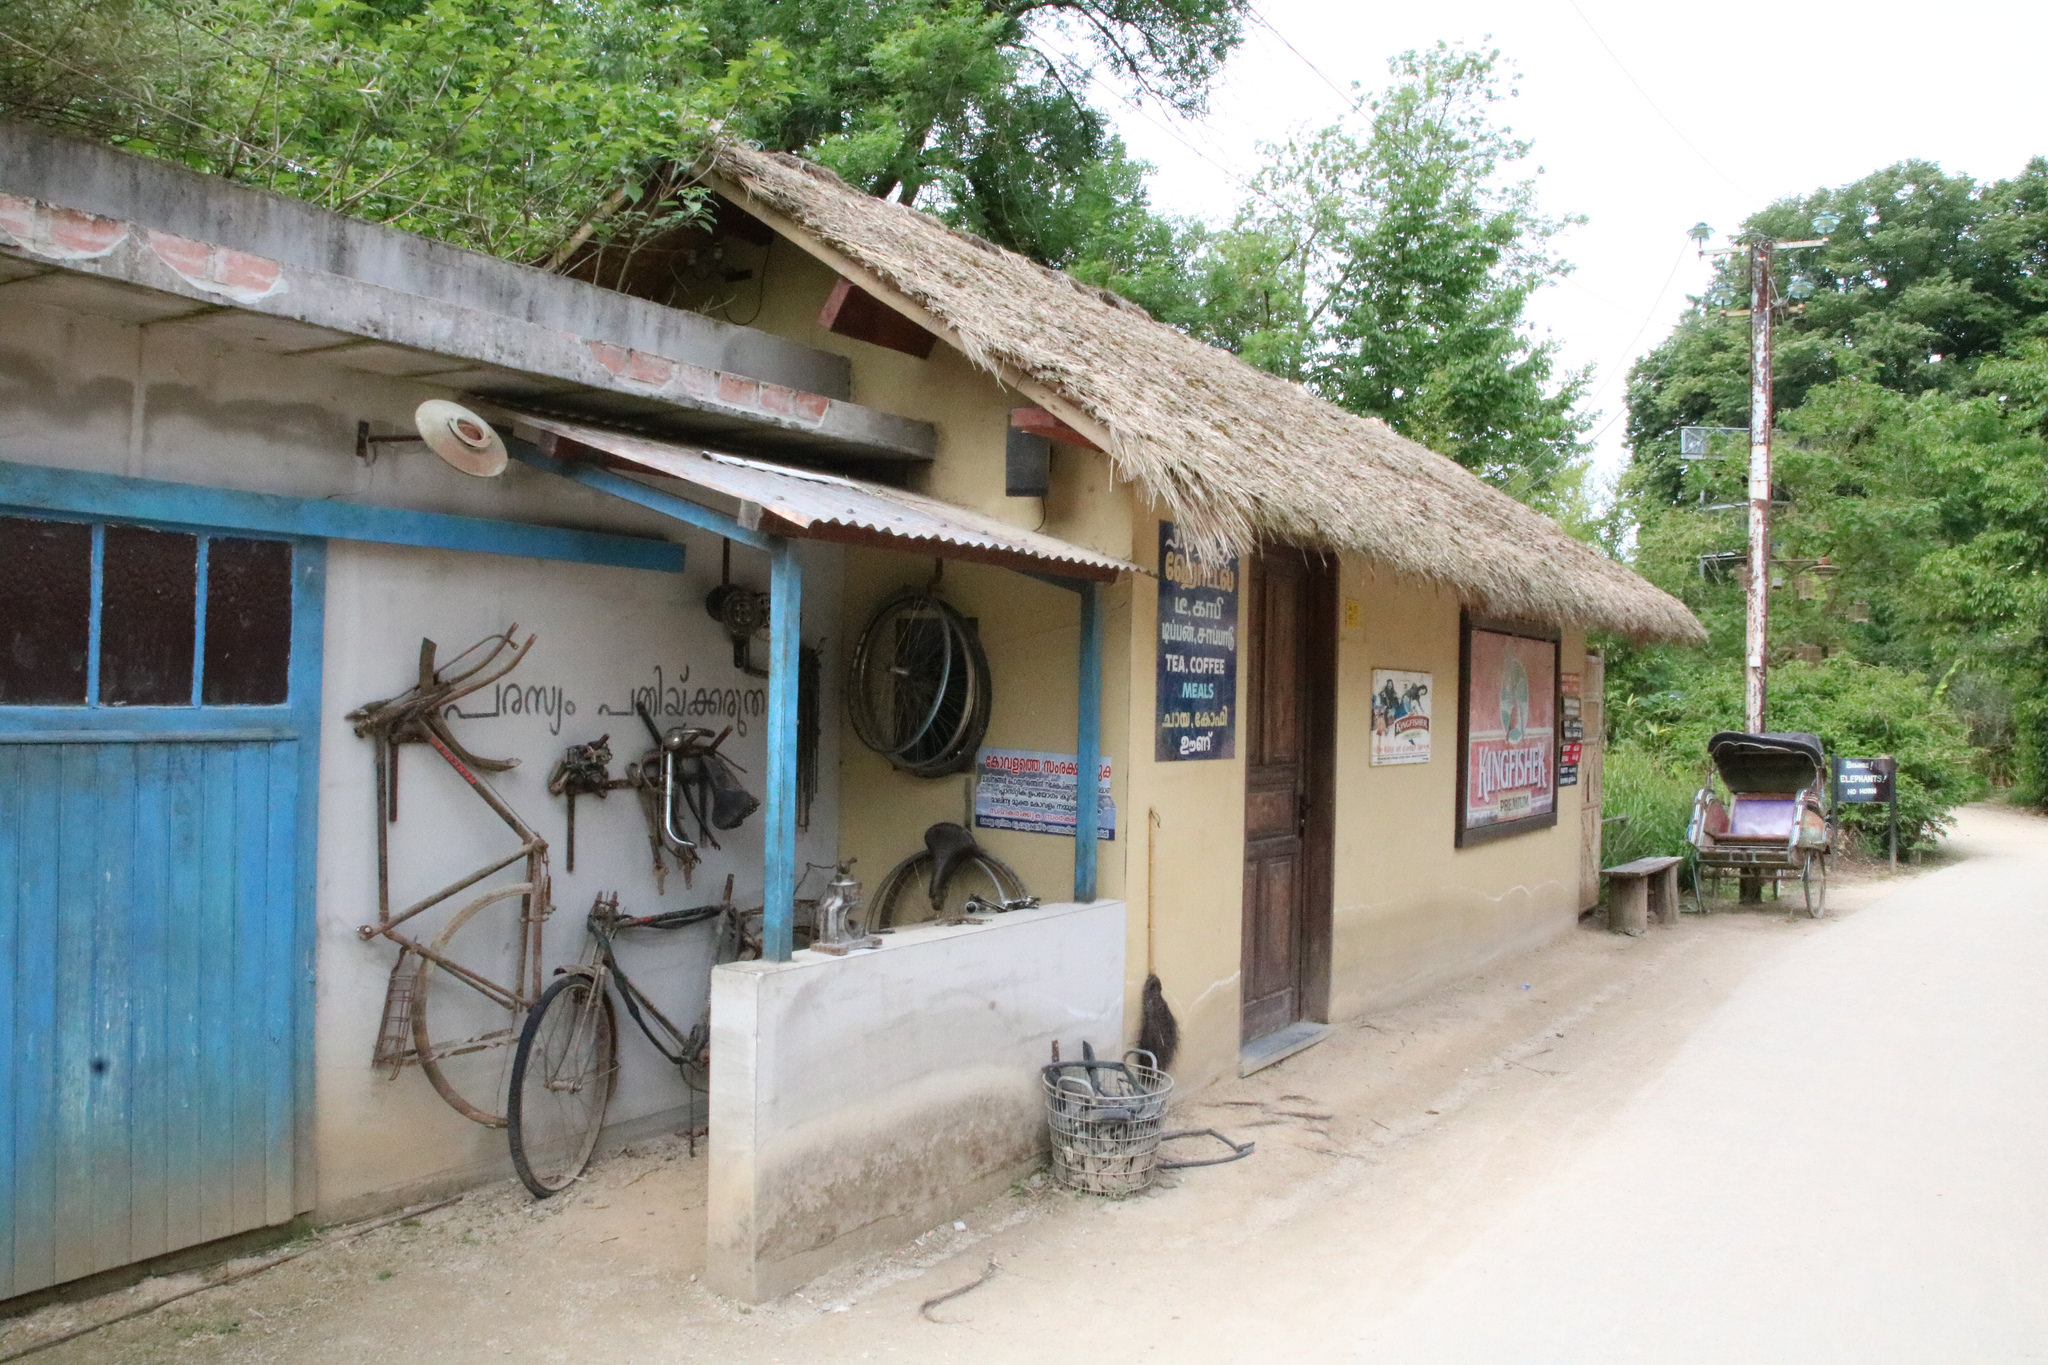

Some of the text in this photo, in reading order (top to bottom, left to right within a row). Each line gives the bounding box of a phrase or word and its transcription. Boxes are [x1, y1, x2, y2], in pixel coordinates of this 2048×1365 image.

[1190, 656, 1225, 675] COFFEE
[1182, 682, 1214, 699] MEALS
[443, 683, 577, 735] പരസ്യം
[985, 755, 1041, 775] കോവളത്തെ
[1477, 743, 1547, 803] KINGFISHER
[1500, 795, 1530, 812] PREMIUM
